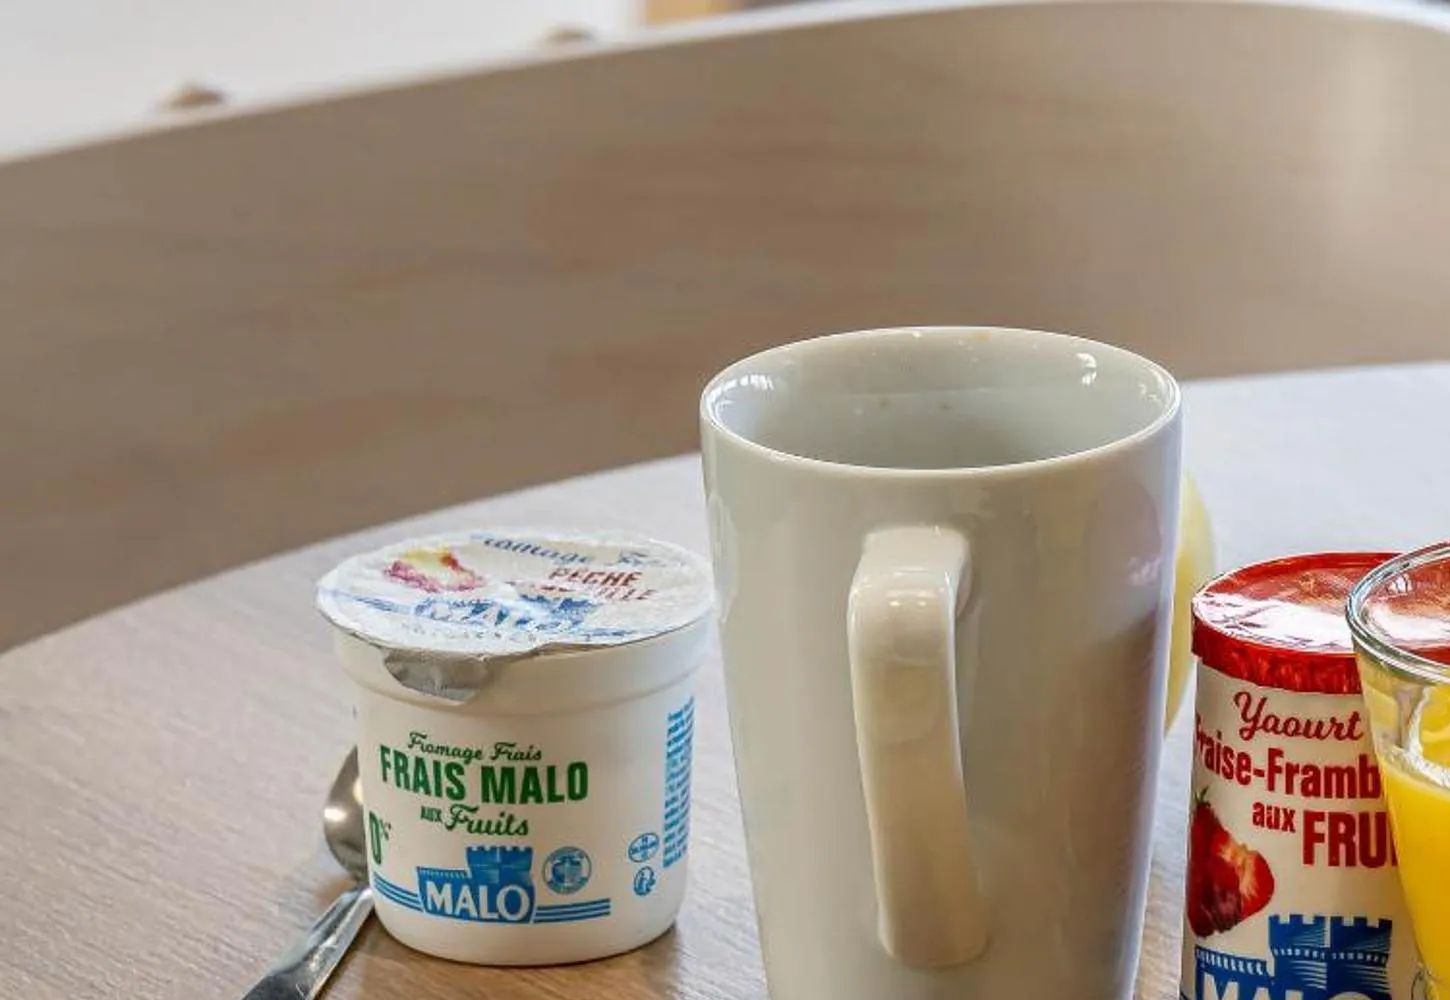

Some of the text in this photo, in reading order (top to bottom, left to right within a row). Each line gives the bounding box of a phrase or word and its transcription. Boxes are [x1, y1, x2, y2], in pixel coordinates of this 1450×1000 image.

[1233, 690, 1365, 742] Yaourt
[407, 732, 543, 764] Fromage Frais
[1195, 711, 1383, 800] raise-Framb
[380, 744, 589, 805] FRAIS MALO
[445, 804, 529, 837] Fruits
[1252, 800, 1297, 834] aux
[424, 879, 530, 922] MALO
